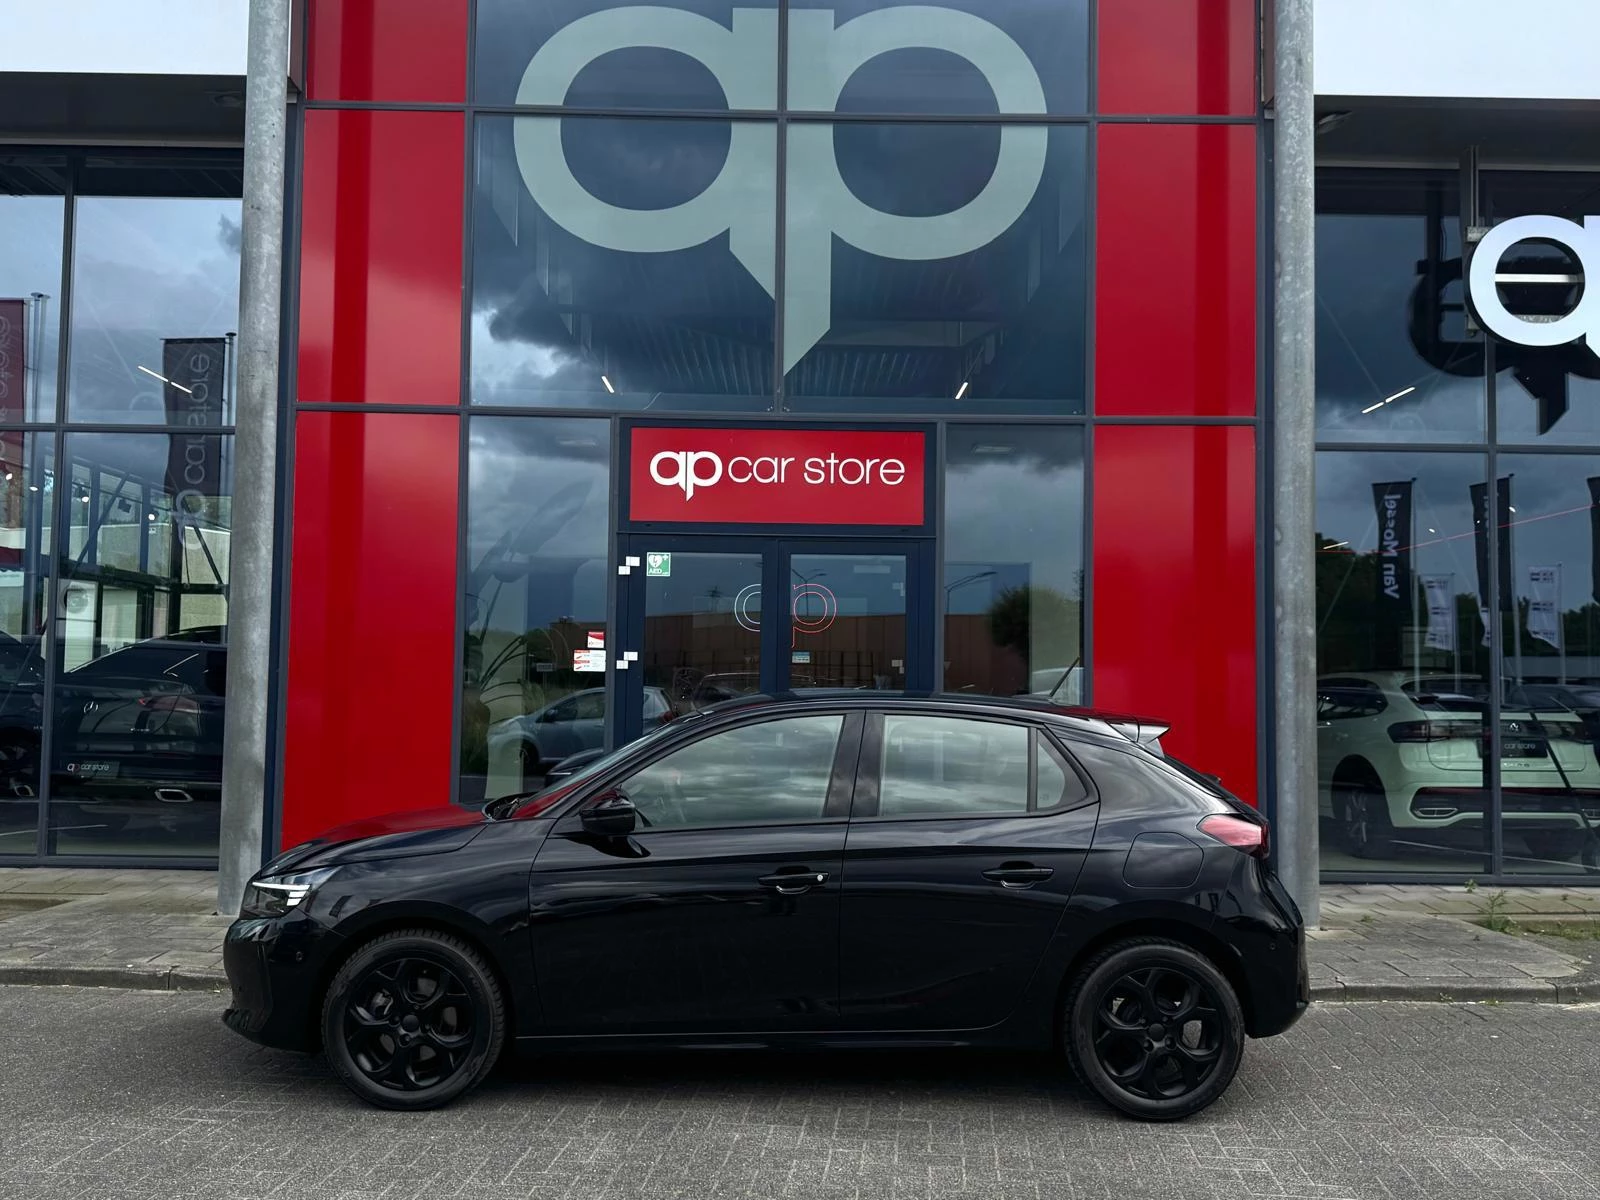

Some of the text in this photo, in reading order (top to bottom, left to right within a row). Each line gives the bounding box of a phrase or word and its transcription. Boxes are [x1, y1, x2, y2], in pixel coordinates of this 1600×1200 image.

[650, 451, 905, 502] ap car store
